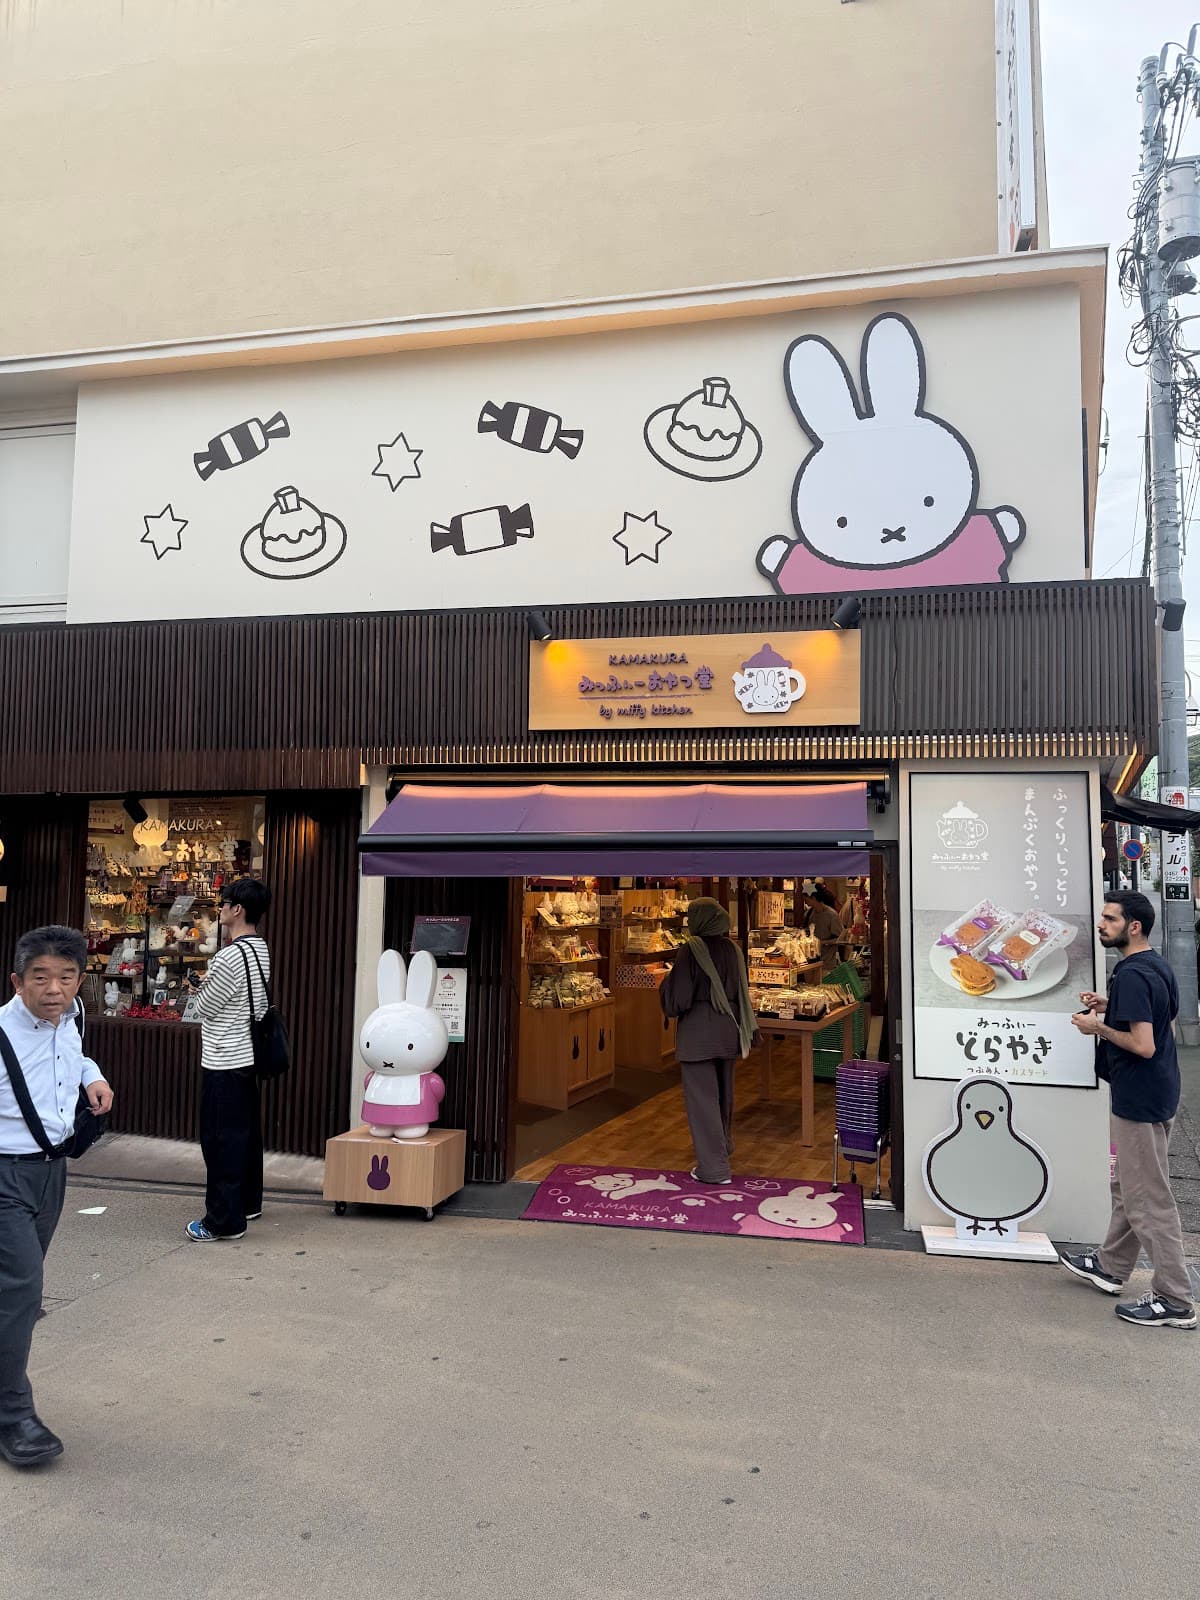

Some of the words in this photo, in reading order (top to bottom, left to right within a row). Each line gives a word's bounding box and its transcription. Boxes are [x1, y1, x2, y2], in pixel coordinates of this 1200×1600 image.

[608, 653, 688, 666] KAMAKURA
[578, 665, 714, 693] みっふぃーおやつ堂
[599, 704, 612, 720] by
[617, 704, 646, 719] miffy
[651, 704, 693, 716] kitchen
[1053, 787, 1069, 907] ふっくり、しっとり
[976, 1017, 1036, 1029] みっふぃー
[956, 1031, 1052, 1064] どらやき
[583, 1201, 671, 1213] KAMAKURA
[561, 1209, 689, 1224] みっふぃーおやつ堂
